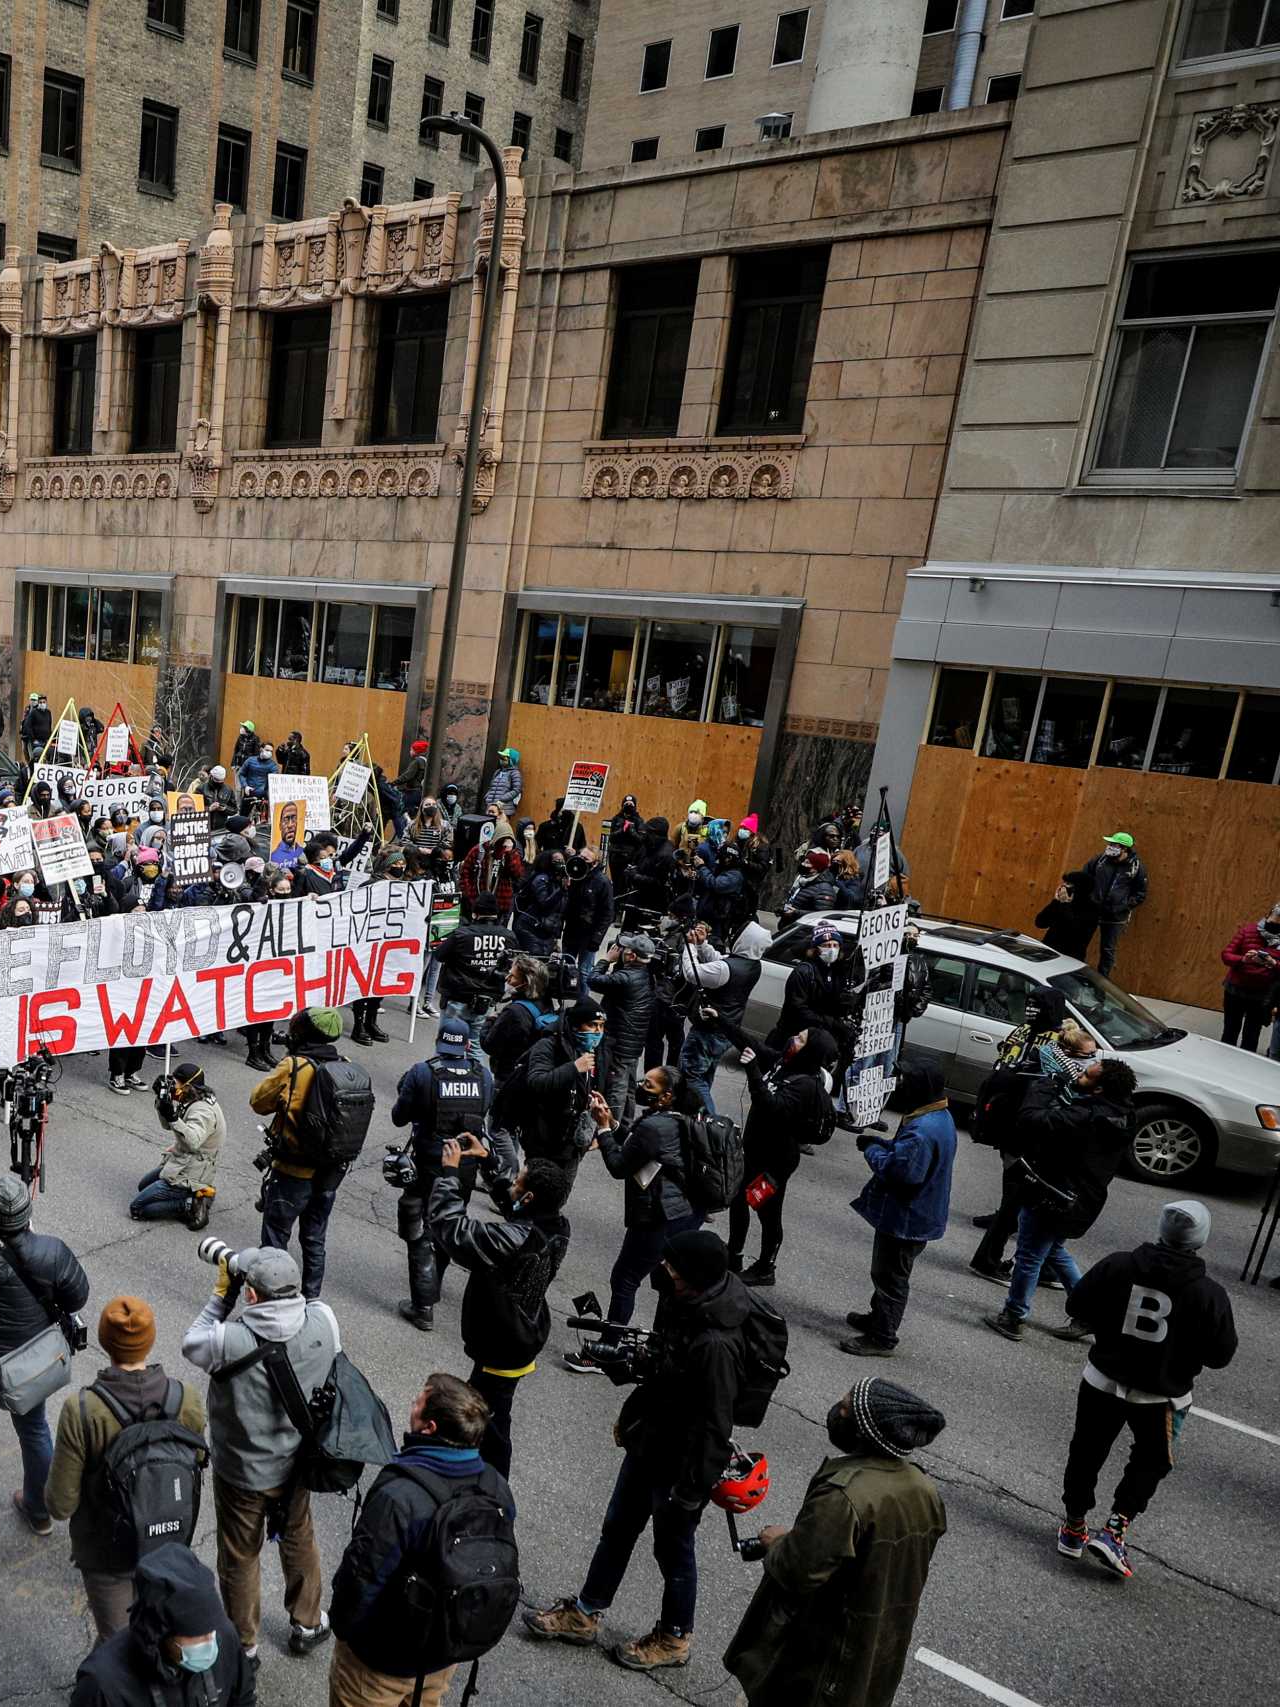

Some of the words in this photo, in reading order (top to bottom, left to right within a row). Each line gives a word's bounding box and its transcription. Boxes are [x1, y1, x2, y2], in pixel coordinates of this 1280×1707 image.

[84, 780, 150, 799] GEORGE
[90, 801, 140, 817] FLYD
[172, 820, 209, 836] JUSTICE
[185, 835, 195, 843] FOR
[173, 842, 209, 860] GEORGE
[173, 856, 209, 877] FLOYD
[314, 879, 427, 920] STOLEN
[330, 908, 405, 948] LIVES
[45, 905, 221, 990] FLOYD
[226, 903, 254, 965] &
[257, 900, 316, 960] ALL
[473, 934, 506, 952] DEUS
[862, 938, 899, 965] FLOYD
[16, 986, 84, 1063] IS
[96, 938, 422, 1048] WATCHING
[442, 1031, 464, 1043] PRESS
[860, 1066, 883, 1083] FOUR
[441, 1081, 480, 1097] MEDIA
[848, 1079, 895, 1101] DIRECTIONS
[857, 1097, 883, 1113] BLACK
[1121, 1283, 1173, 1343] B
[149, 1520, 180, 1537] PRESS
